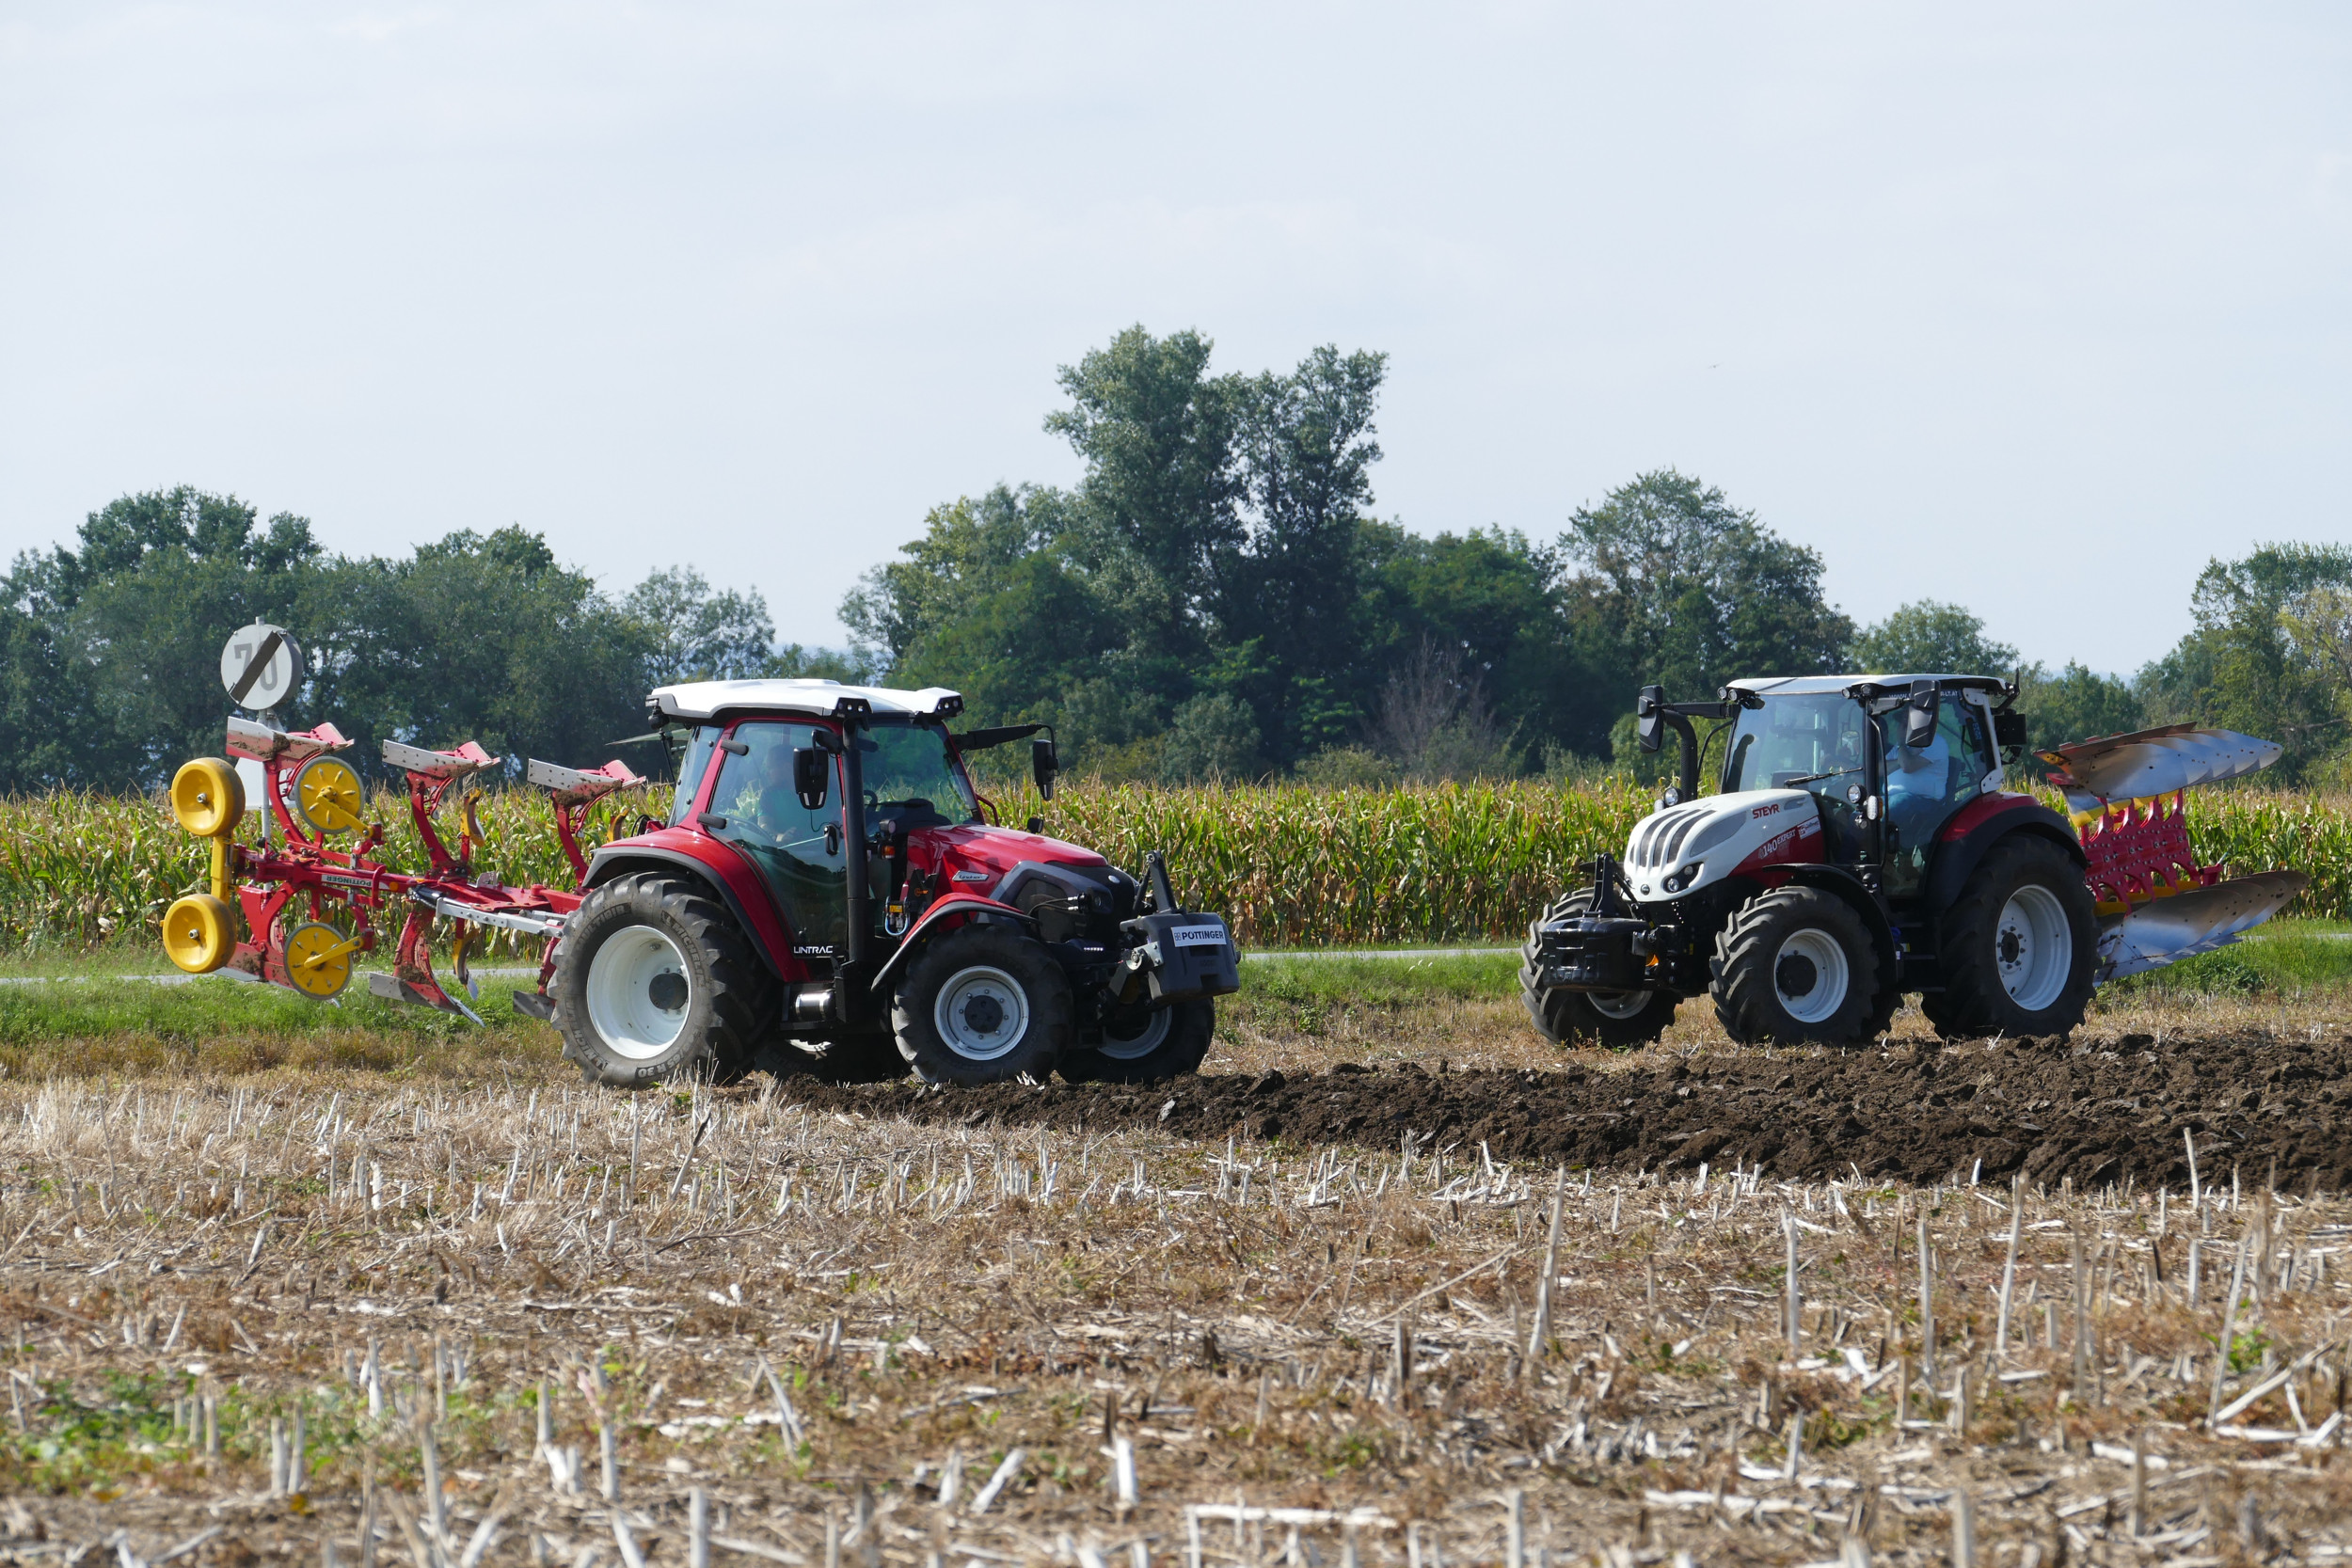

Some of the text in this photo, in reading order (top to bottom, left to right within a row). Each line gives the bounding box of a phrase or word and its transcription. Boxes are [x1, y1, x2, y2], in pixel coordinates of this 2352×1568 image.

[234, 640, 278, 691] 70
[1752, 803, 1780, 819] STEYR
[1776, 829, 1796, 845] EXPERT
[793, 945, 834, 954] LINTRAC
[637, 1067, 656, 1079] 30
